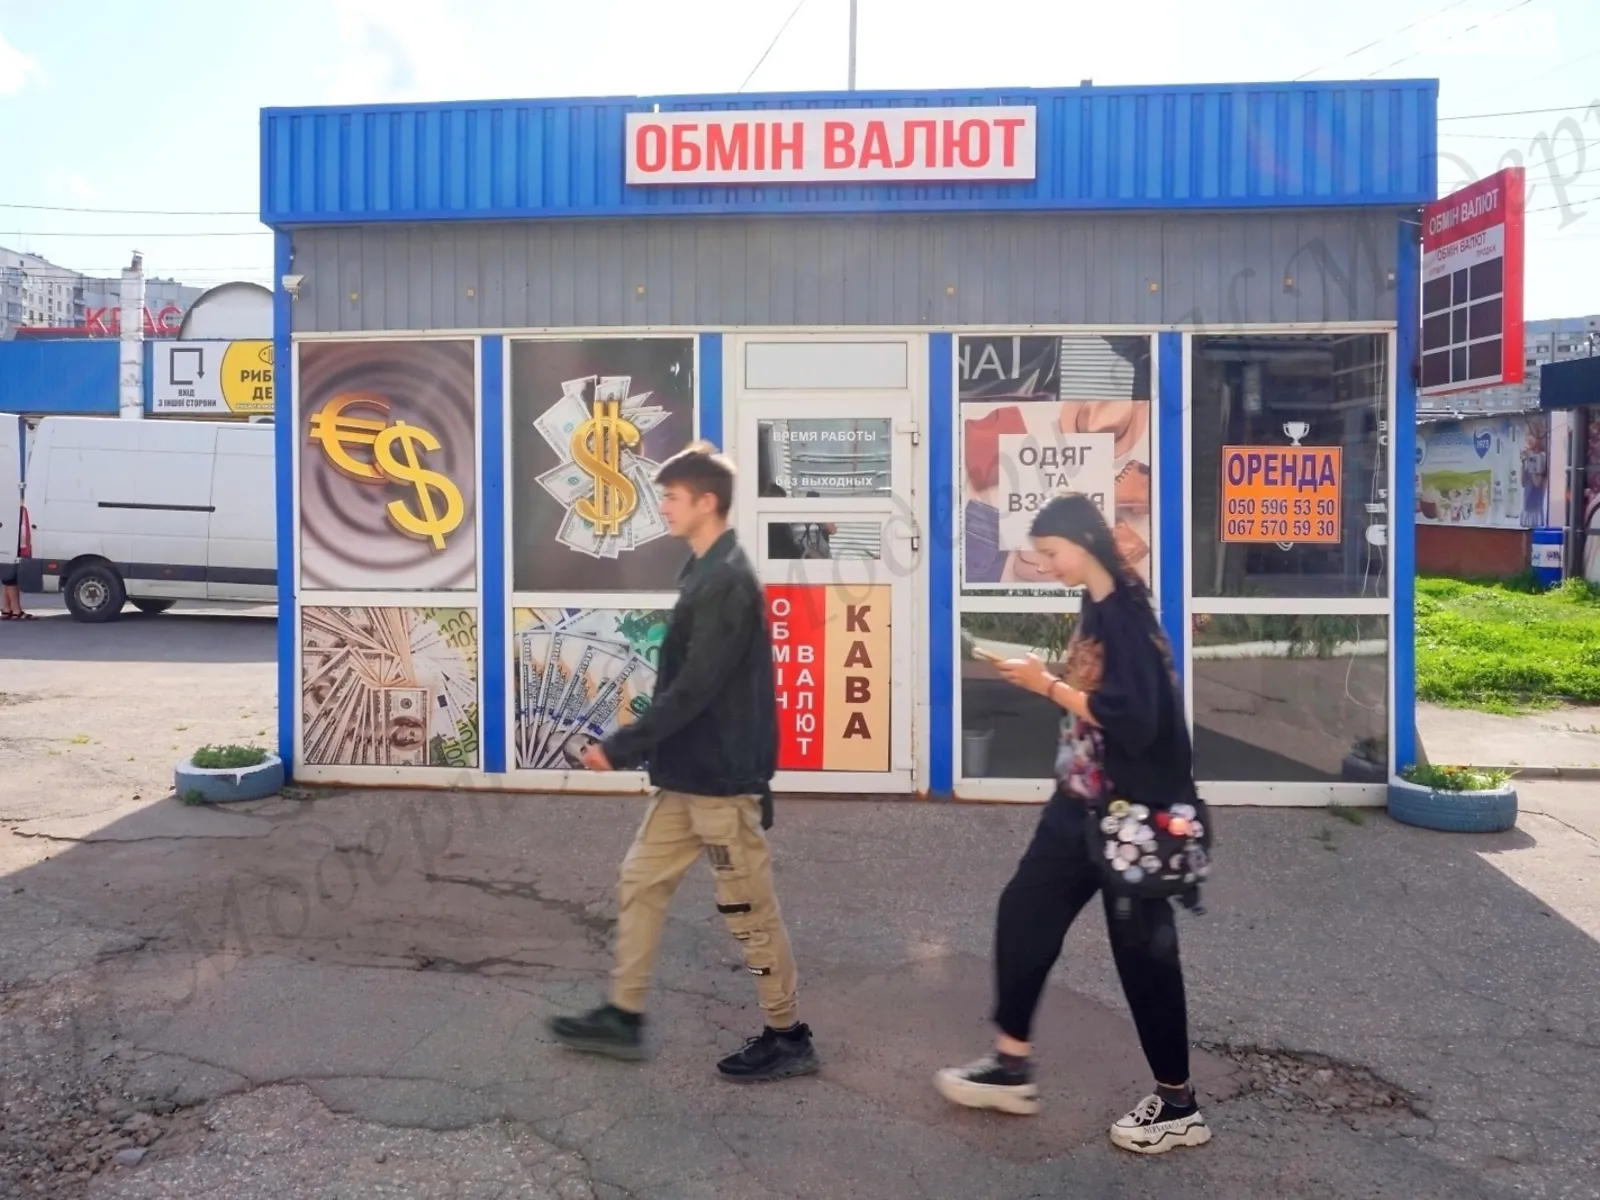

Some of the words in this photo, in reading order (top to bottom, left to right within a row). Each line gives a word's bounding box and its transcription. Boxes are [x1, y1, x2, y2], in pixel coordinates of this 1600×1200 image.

[635, 121, 804, 173] ОБМІН
[822, 118, 1026, 170] ВАЛЮТ
[1429, 205, 1460, 236] ОБМІН
[1461, 188, 1500, 223] ВАЛЮТ
[1437, 244, 1459, 261] ОБМІН
[1460, 231, 1488, 253] ВАЛЮТ
[84, 305, 182, 334] КАС
[178, 388, 195, 397] ВХІД
[186, 399, 217, 407] СТОРОНИ
[773, 431, 818, 442] ВРЕМЯ
[821, 431, 876, 441] РАБОТЫ
[1019, 446, 1093, 469] ОДЯГ
[1044, 473, 1069, 488] ТА
[1227, 452, 1336, 493] ОРЕНДА
[1008, 493, 1105, 512] ВЗЯ
[1228, 498, 1256, 515] 050
[1261, 499, 1288, 515] 596
[1293, 498, 1311, 515] 53
[1317, 499, 1335, 516] 50
[1228, 519, 1256, 535] 067
[1261, 519, 1288, 536] 570
[1293, 519, 1311, 536] 59
[1317, 520, 1335, 536] 30
[771, 598, 791, 709] ОБМІН
[842, 605, 873, 740] КАВА
[796, 645, 816, 756] ВАЛЮТ
